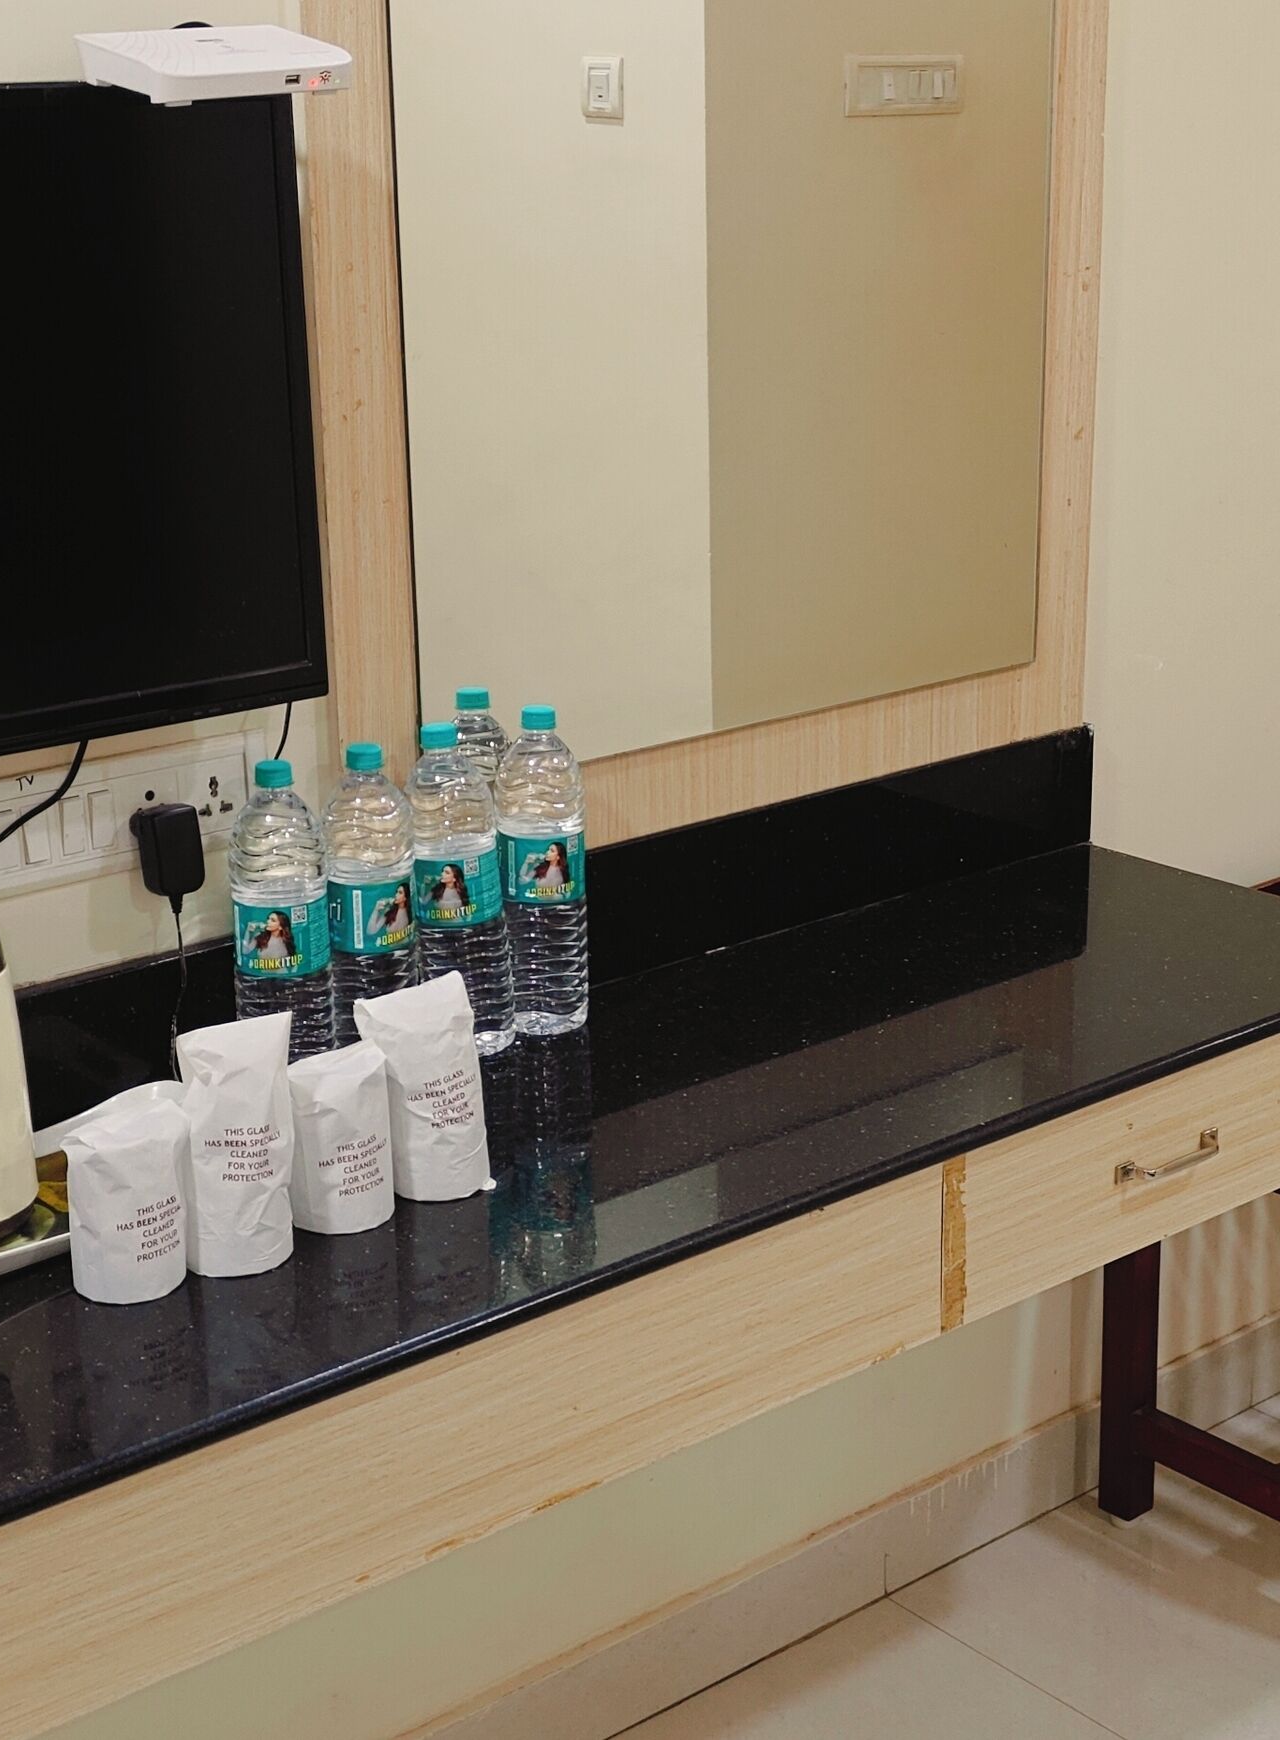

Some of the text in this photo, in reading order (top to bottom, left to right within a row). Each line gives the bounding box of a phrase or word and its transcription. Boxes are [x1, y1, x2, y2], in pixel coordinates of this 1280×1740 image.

[16, 774, 34, 791] TV
[424, 1069, 464, 1090] THIS GLASS
[425, 1089, 446, 1099] BEEN
[447, 1073, 477, 1094] SPECIALLY
[432, 1092, 466, 1109] CLEANED
[432, 1101, 469, 1120] FOR YOUR
[431, 1110, 474, 1129] PROTECTION
[224, 1128, 244, 1136] THIS
[230, 1148, 268, 1158] CLEANED
[336, 1143, 355, 1153] THIS
[228, 1159, 269, 1170] FOR YOUR
[319, 1158, 335, 1168] HAS
[337, 1154, 359, 1164] BEEN
[344, 1158, 377, 1174] CLEANED
[222, 1169, 273, 1182] PROTECTION
[342, 1167, 380, 1185] FOR YOUR
[339, 1176, 384, 1197] PROTECTION
[136, 1204, 154, 1217] THIS
[116, 1222, 134, 1232] HAS
[136, 1216, 158, 1228] BEEN
[142, 1218, 174, 1238] CLEANED
[142, 1229, 178, 1250] FOR YOUR
